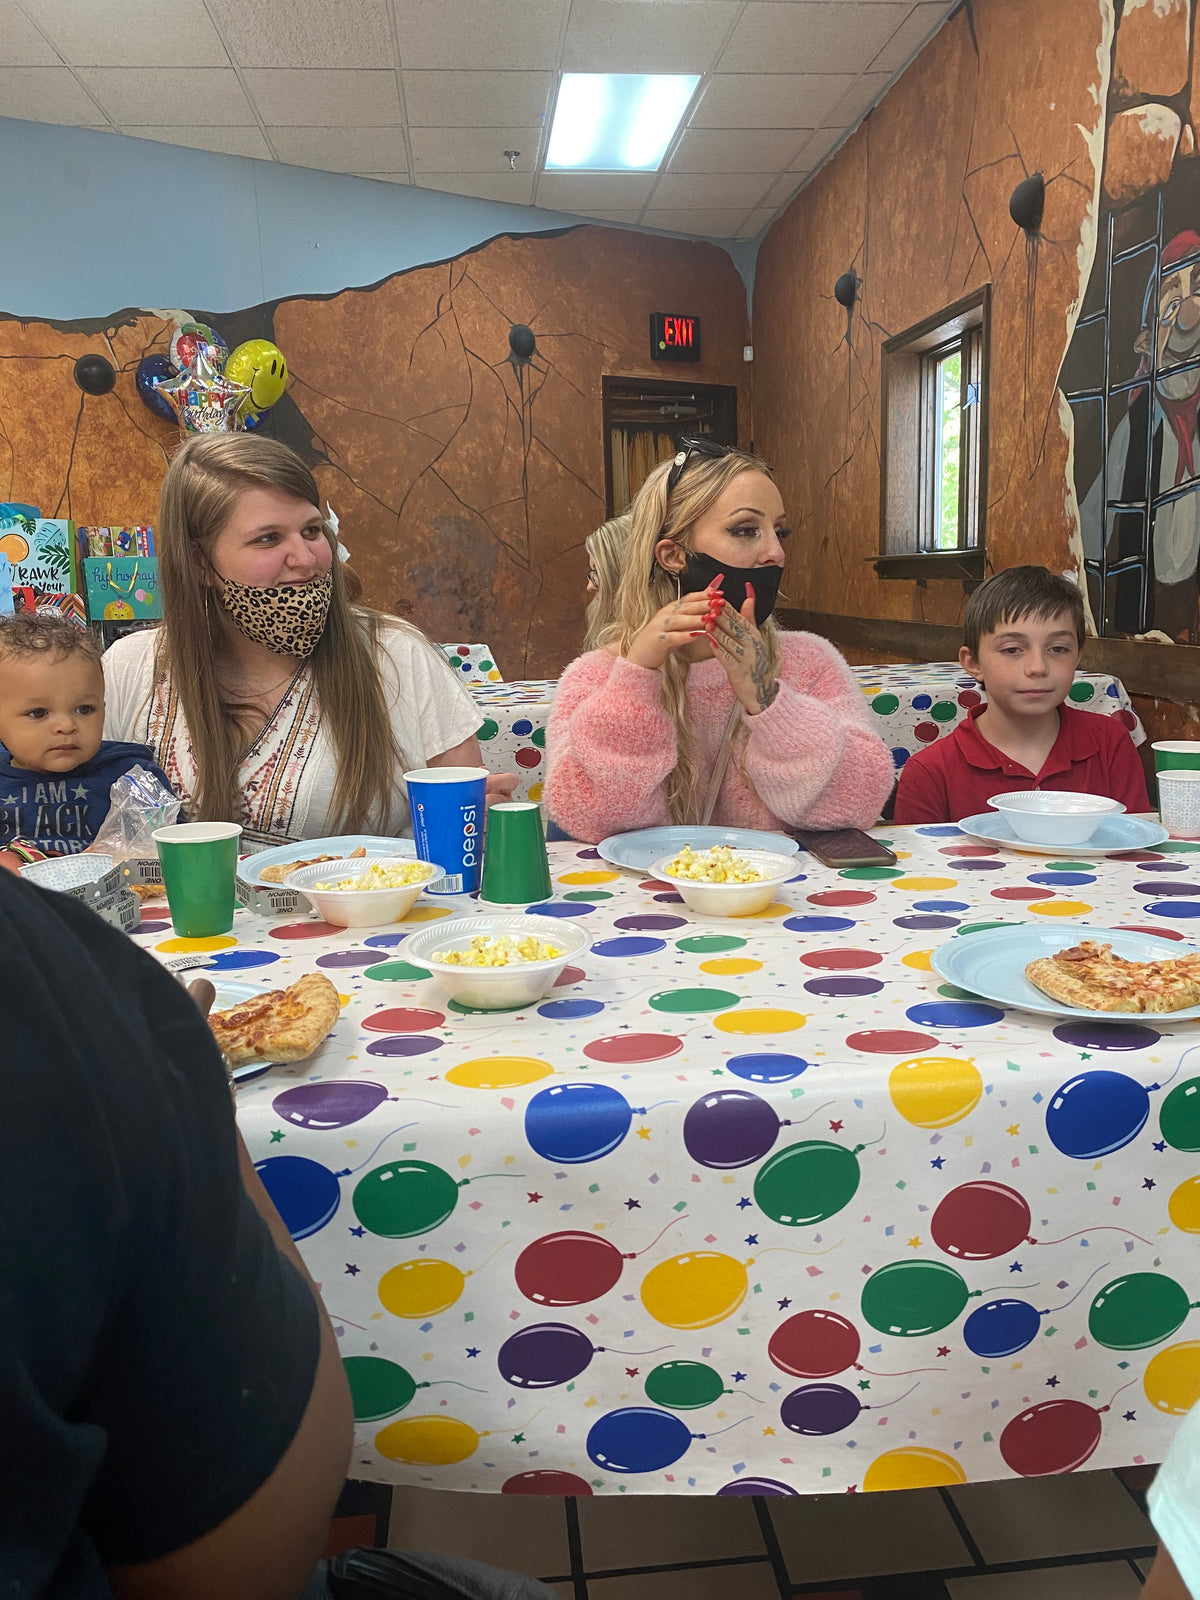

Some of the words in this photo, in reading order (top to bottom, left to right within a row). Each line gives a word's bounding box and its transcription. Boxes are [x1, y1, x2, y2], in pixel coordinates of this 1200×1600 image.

[664, 316, 694, 347] EXIT
[181, 406, 226, 424] Birthday
[18, 566, 60, 580] RAWR
[22, 786, 28, 804] I
[34, 780, 67, 804] AM
[460, 804, 478, 867] pepsi
[267, 890, 299, 898] COUPON
